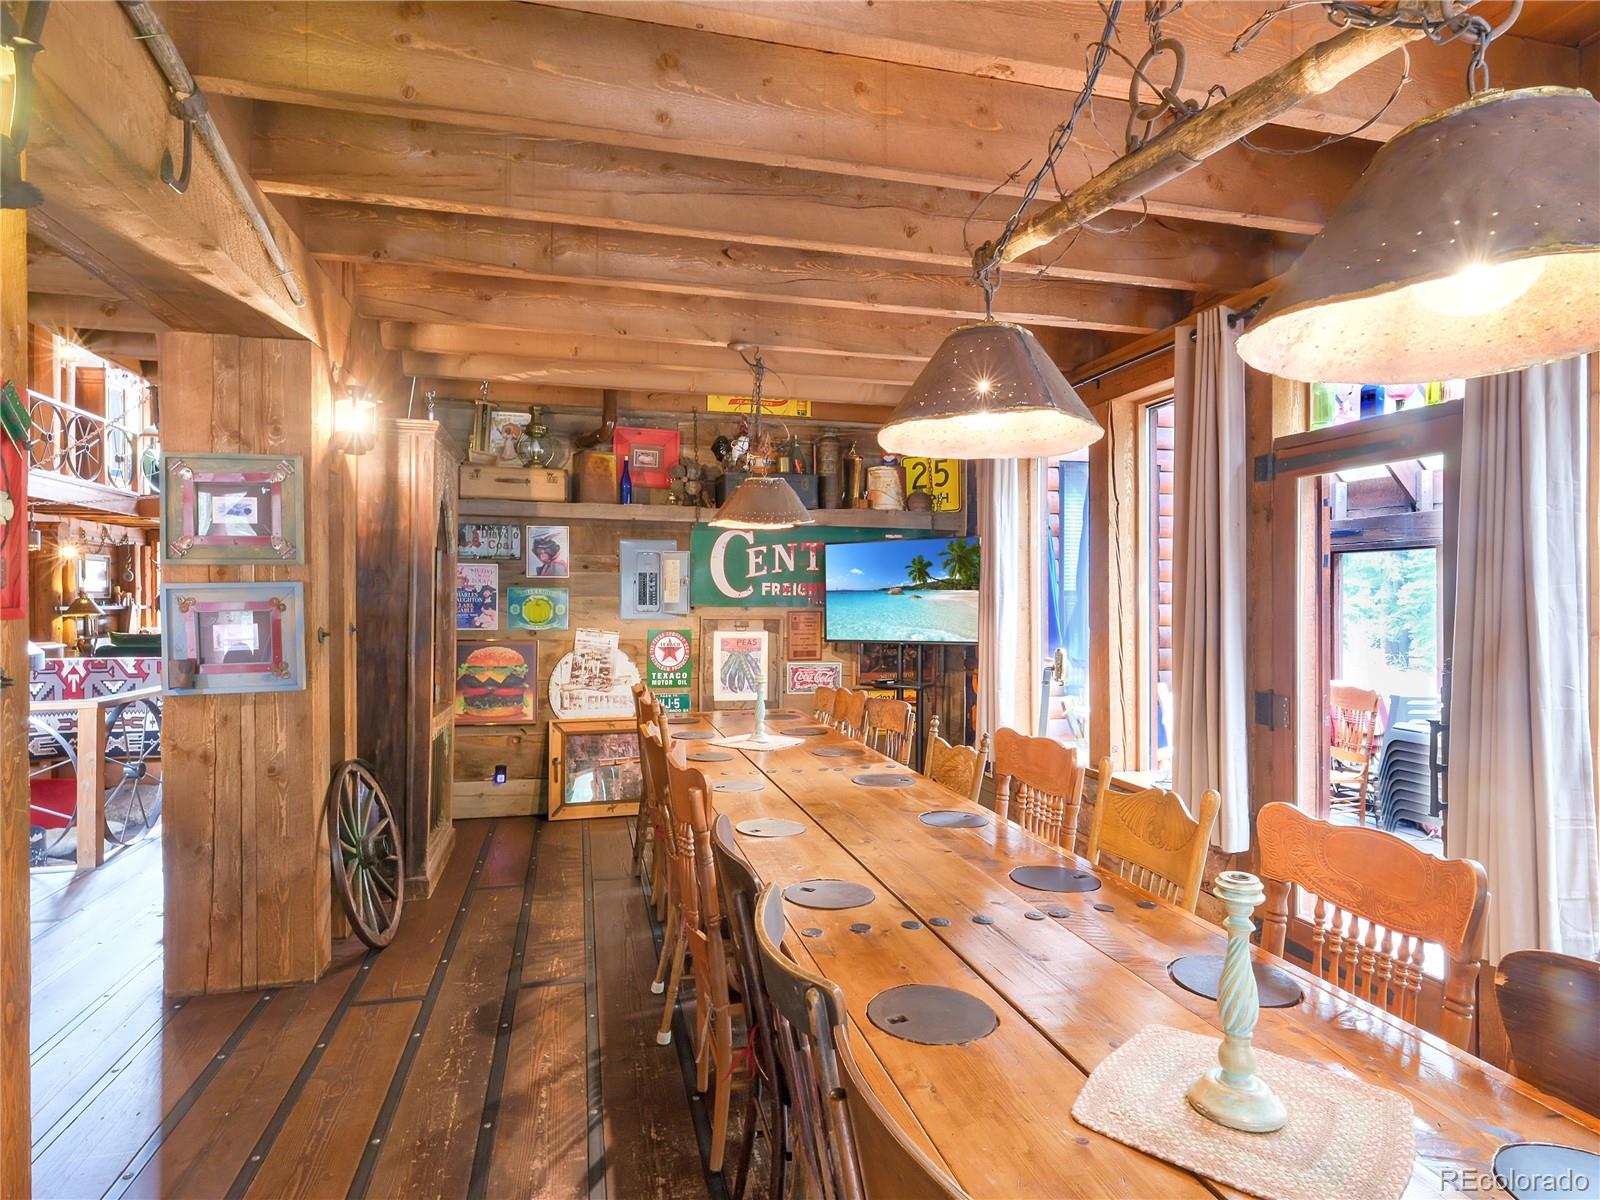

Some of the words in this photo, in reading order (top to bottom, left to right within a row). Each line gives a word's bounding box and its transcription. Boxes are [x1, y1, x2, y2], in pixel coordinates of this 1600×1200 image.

[912, 459, 949, 490] 25
[488, 539, 513, 550] Coal
[651, 672, 688, 680] TEXACO
